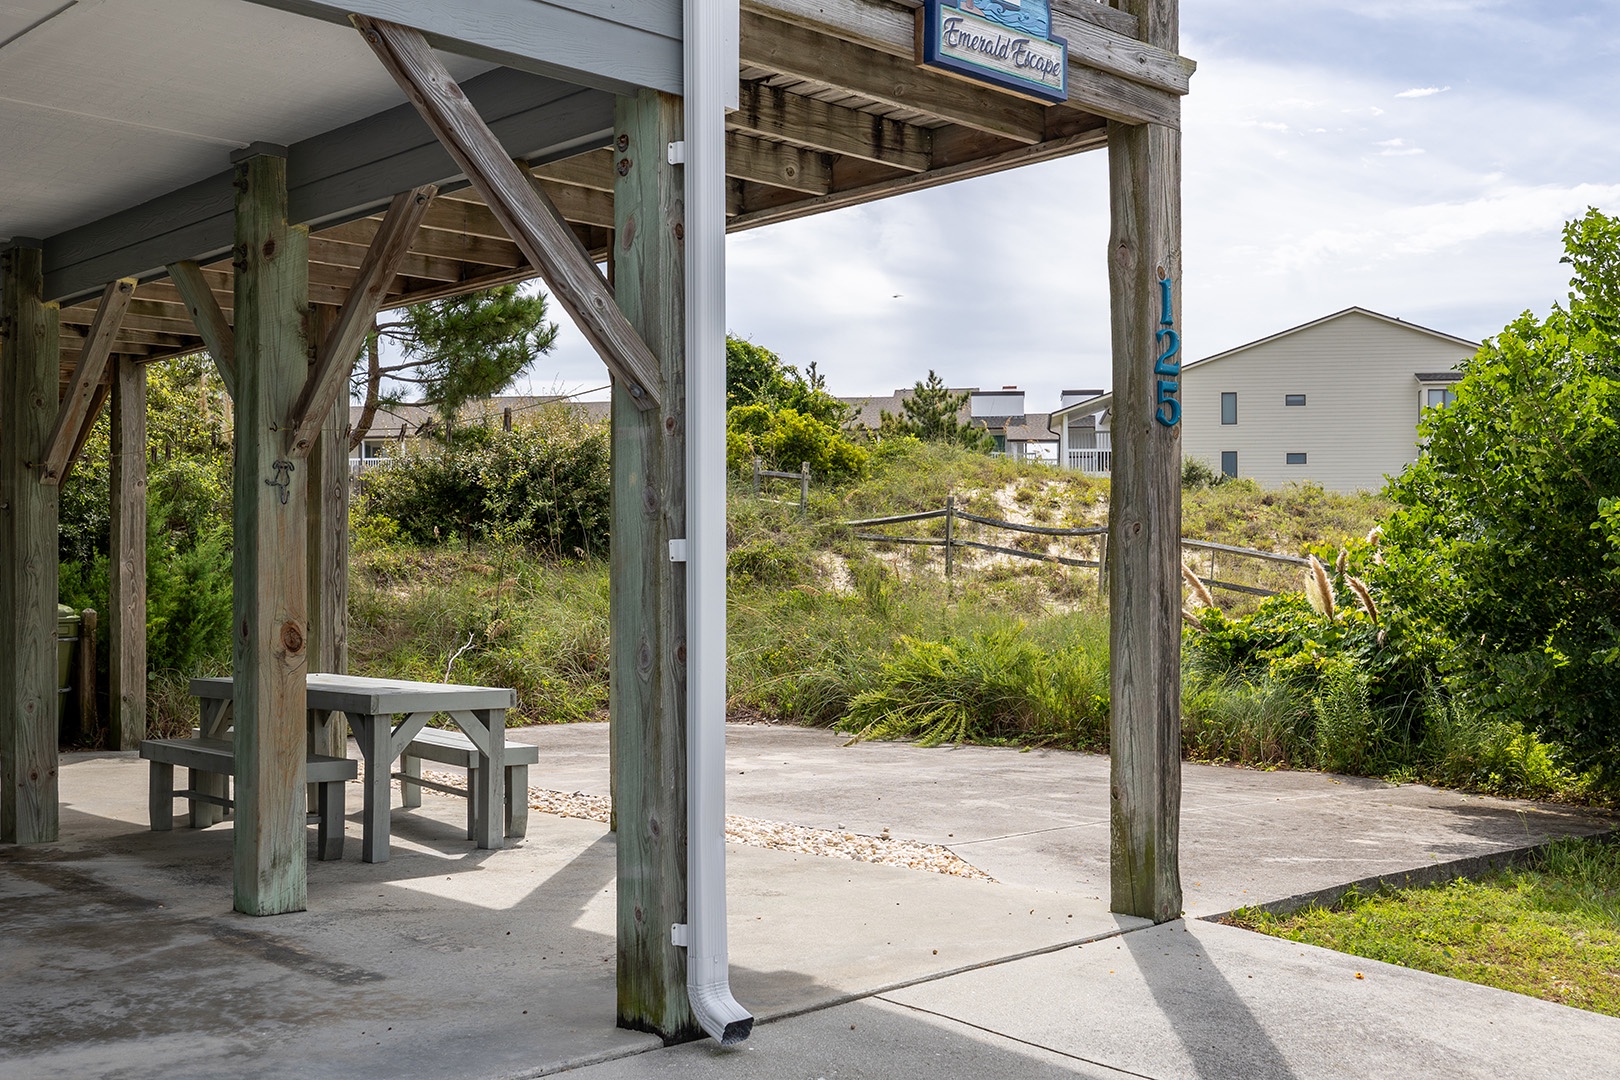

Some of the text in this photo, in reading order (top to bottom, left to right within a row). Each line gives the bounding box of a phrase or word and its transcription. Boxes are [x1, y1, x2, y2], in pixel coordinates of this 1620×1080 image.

[943, 17, 1061, 80] Emerald Escape
[1154, 278, 1181, 427] 125
